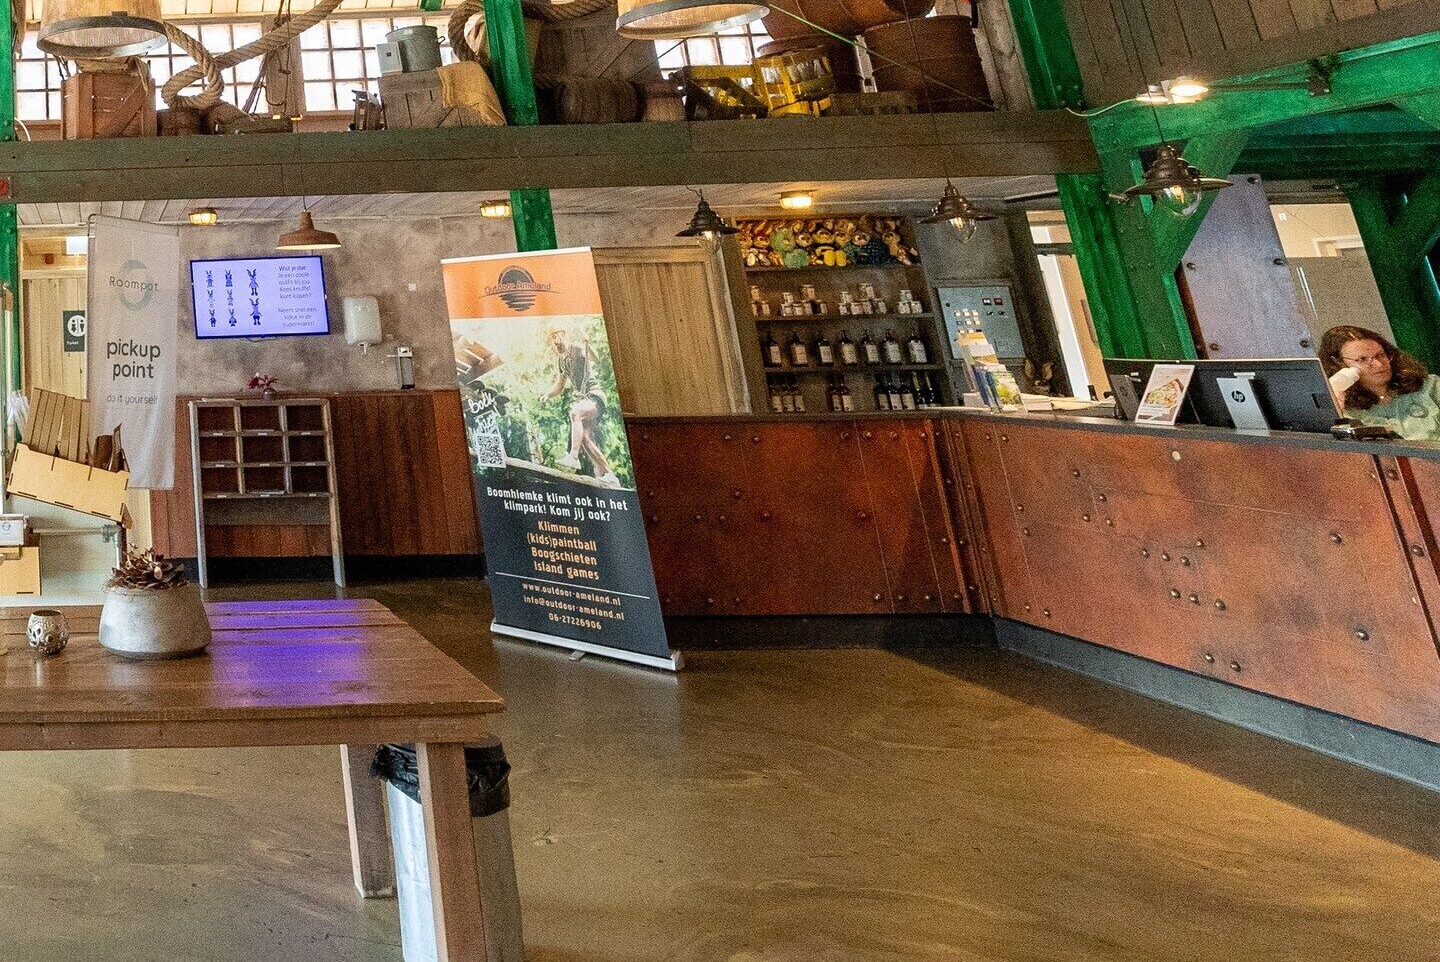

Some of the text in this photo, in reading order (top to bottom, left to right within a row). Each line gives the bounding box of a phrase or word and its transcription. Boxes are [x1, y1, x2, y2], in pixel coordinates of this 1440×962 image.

[109, 275, 159, 292] Roompot
[484, 281, 551, 294] Outdoor Ameland
[106, 339, 161, 362] pickup
[112, 361, 154, 381] point
[124, 394, 158, 406] yourself
[1232, 391, 1245, 403] hp
[487, 487, 628, 511] Boomhiemke klimt ook in het
[504, 499, 610, 521] klimpark! Kom jij ook?
[538, 520, 580, 535] Klimmen
[527, 532, 597, 552] (kids)paintball
[531, 546, 597, 566] Boogschieten
[533, 560, 599, 580] Island games
[522, 582, 621, 606] www.outdoor-ameland.nl
[523, 594, 625, 620] info@outdoor-ameland.nl
[548, 612, 602, 630] 06-27226906
